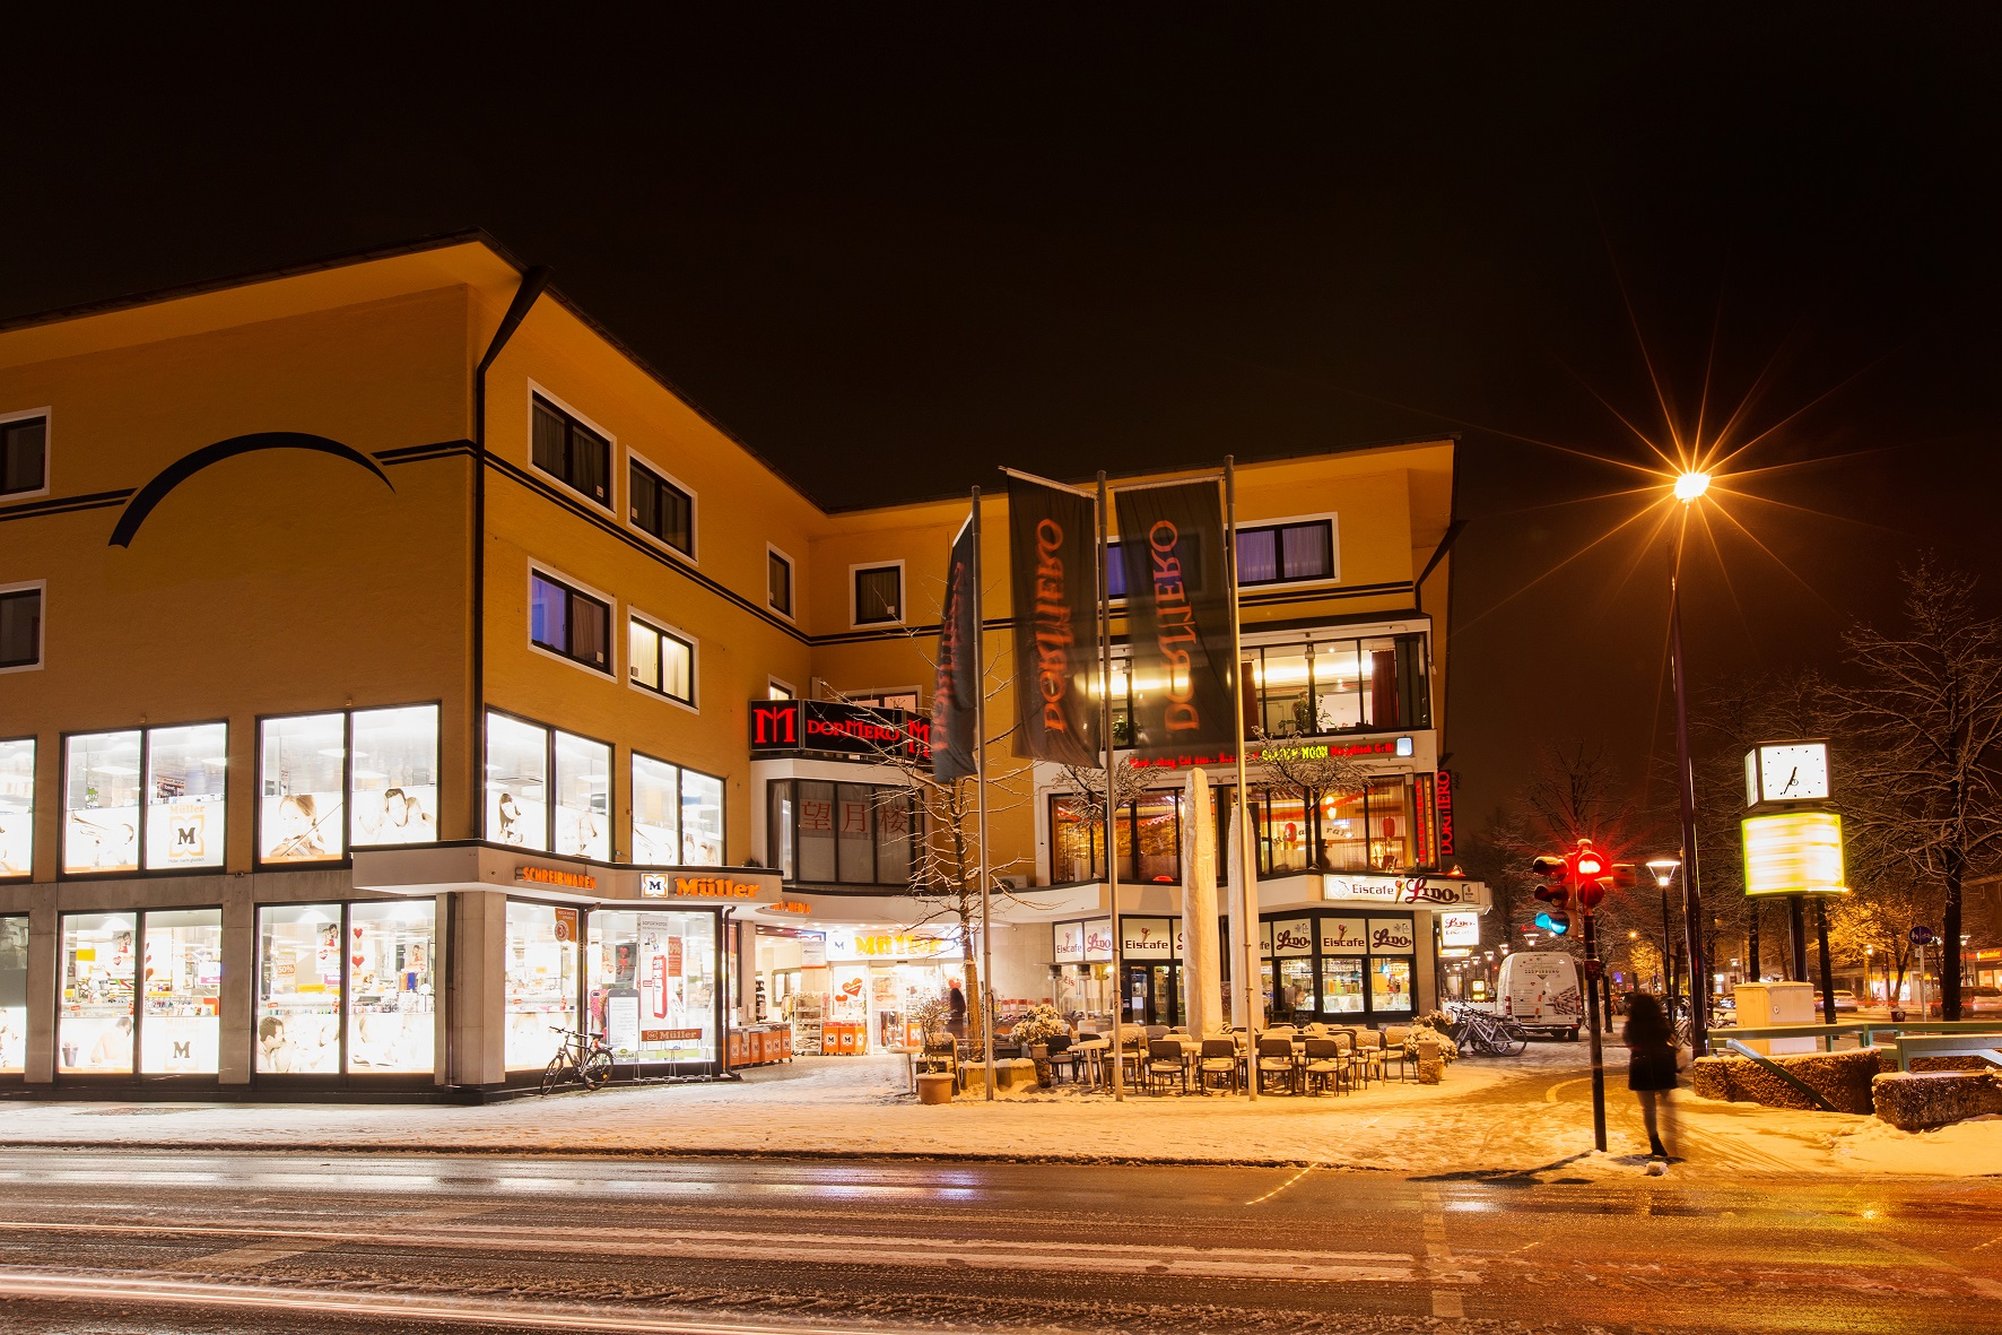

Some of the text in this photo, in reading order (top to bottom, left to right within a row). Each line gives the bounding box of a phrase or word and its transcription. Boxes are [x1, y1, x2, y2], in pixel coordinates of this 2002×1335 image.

[674, 877, 760, 897] Müller
[1352, 883, 1394, 895] Eiscafe
[1125, 940, 1169, 949] Eiscafe
[1323, 937, 1365, 947] Eiscafe
[660, 1031, 697, 1040] Müller
